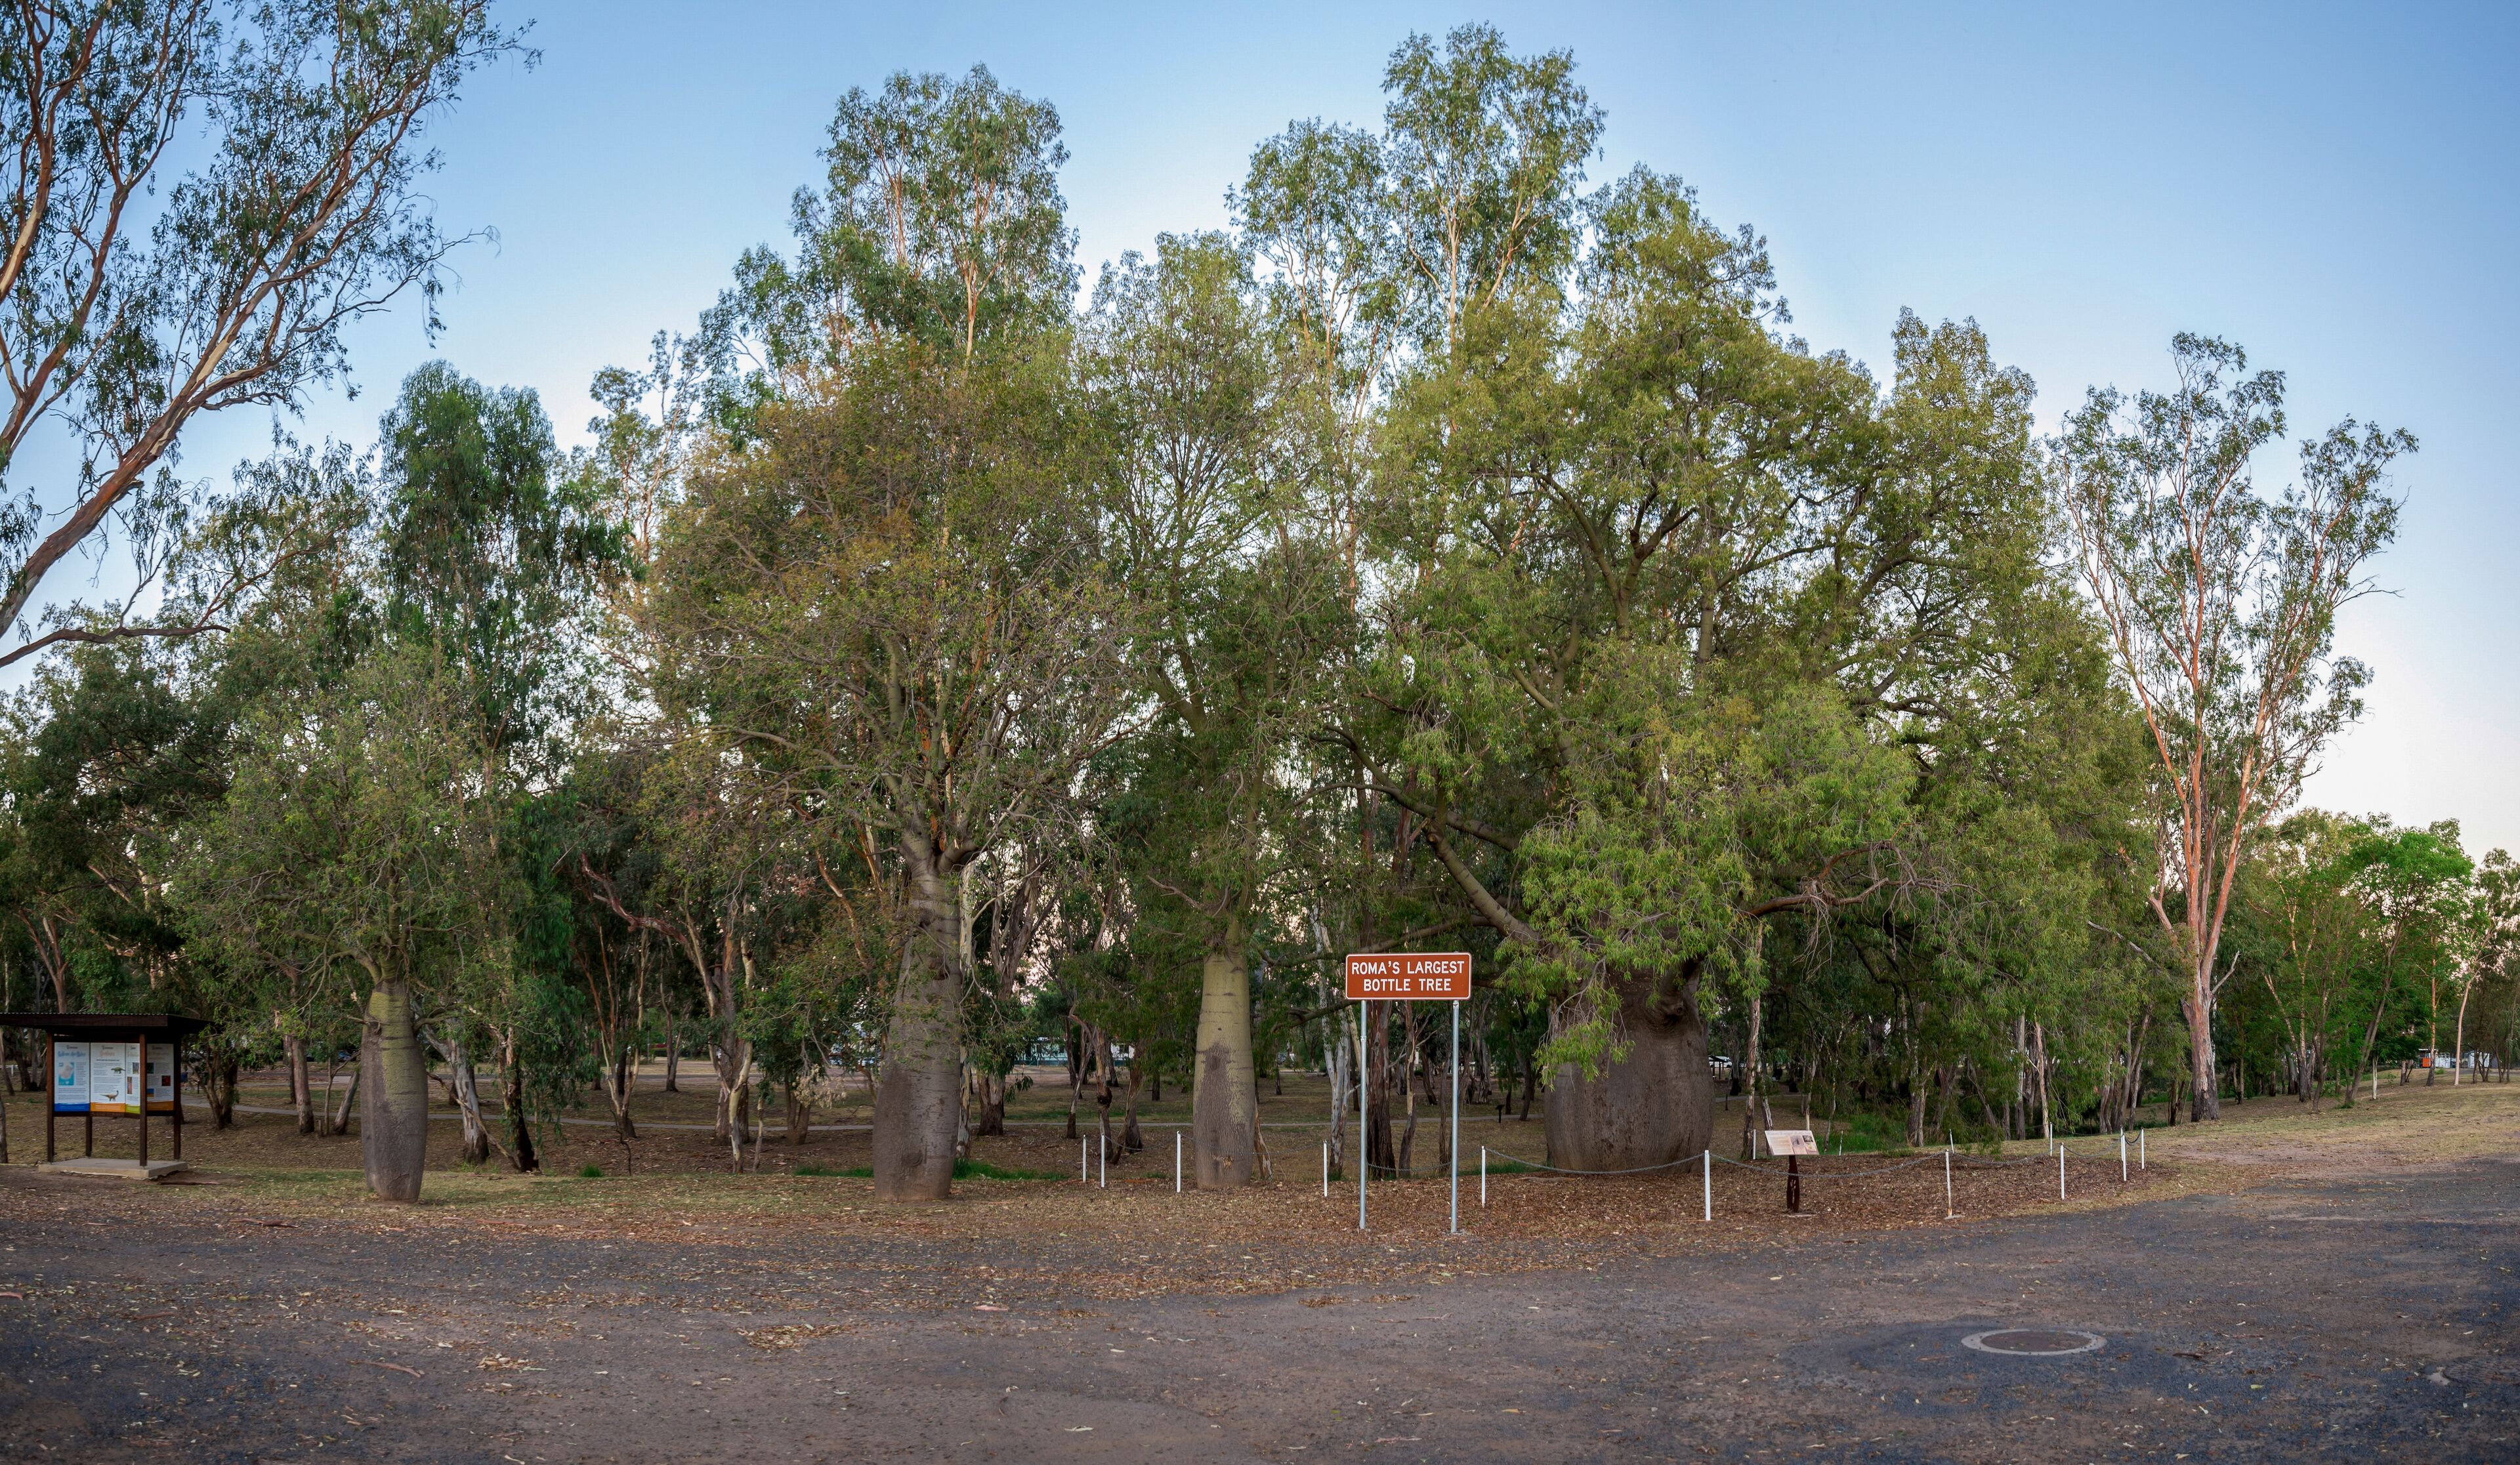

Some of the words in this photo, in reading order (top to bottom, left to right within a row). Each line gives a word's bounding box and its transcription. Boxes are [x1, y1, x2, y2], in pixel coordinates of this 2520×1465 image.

[1351, 960, 1400, 975] ROMA'S
[1407, 960, 1465, 974] LARGEST
[1363, 978, 1411, 991] BOTTLE
[1419, 978, 1452, 991] TREE
